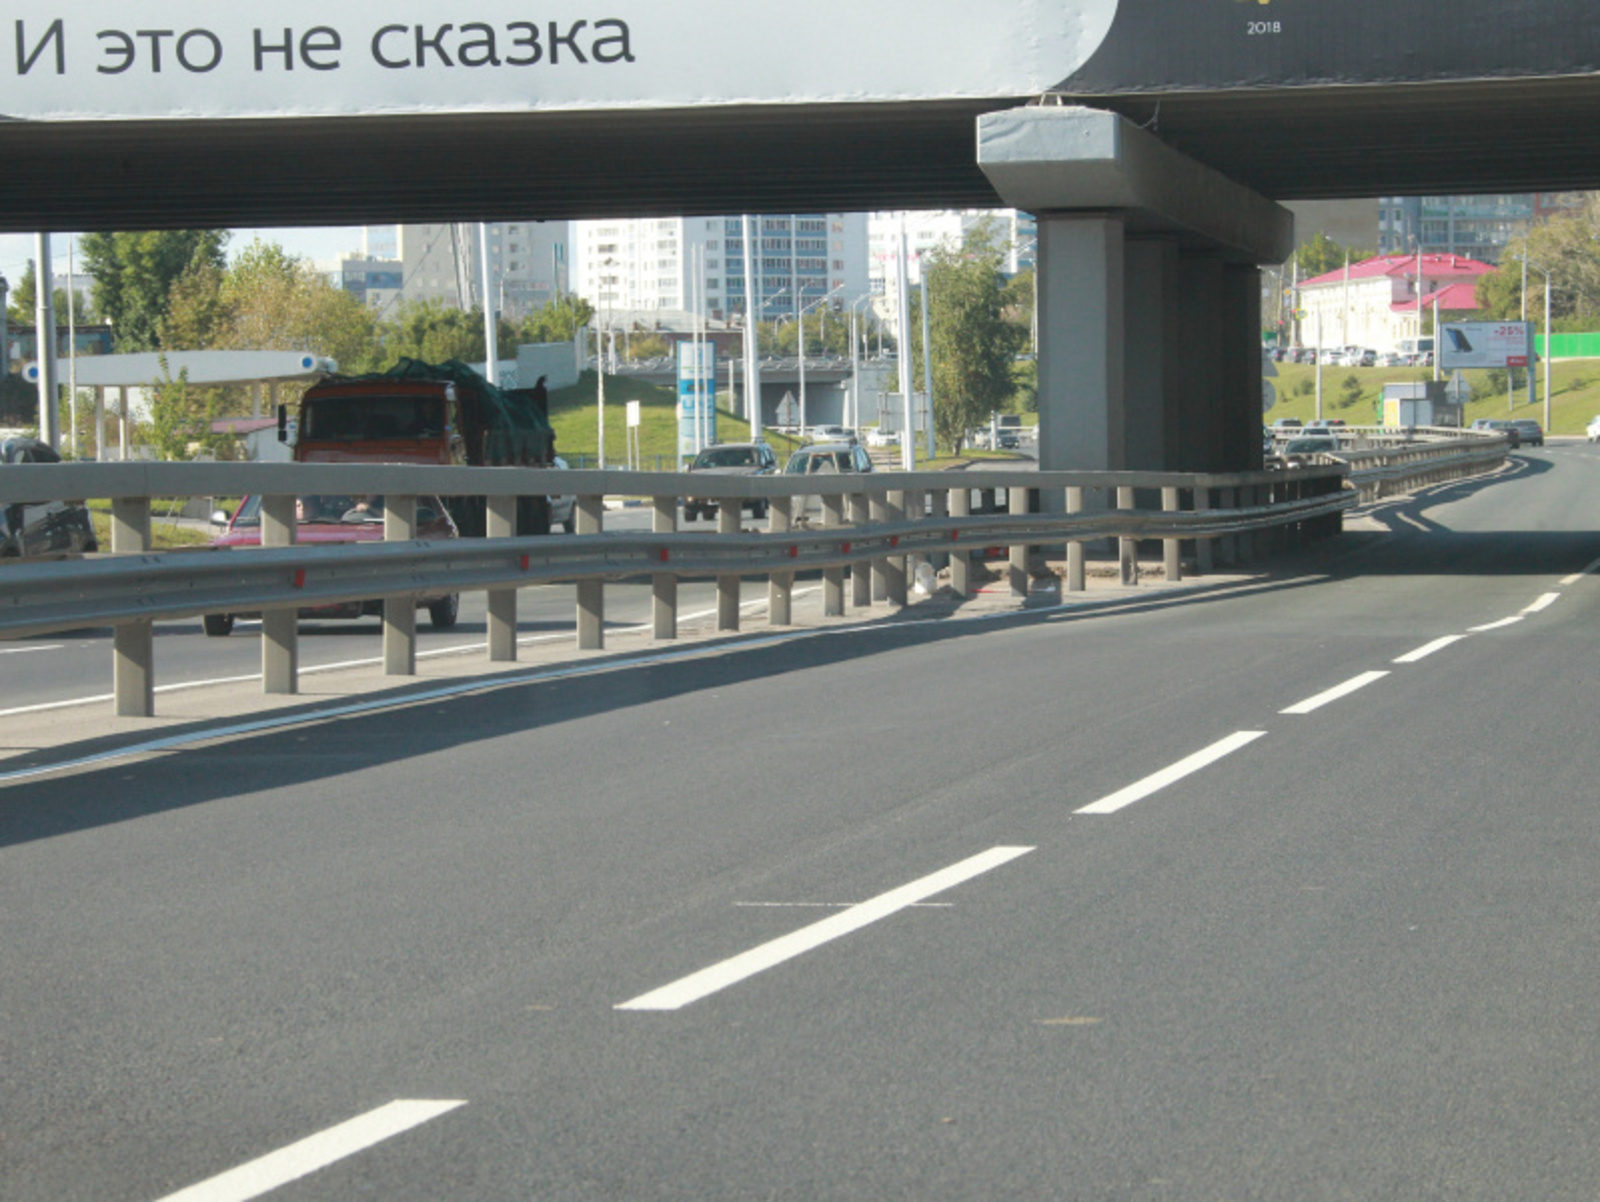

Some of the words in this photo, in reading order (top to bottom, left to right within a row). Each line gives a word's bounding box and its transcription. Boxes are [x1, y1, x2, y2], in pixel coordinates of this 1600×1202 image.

[1247, 21, 1281, 35] 2018
[15, 19, 65, 75] И
[96, 28, 223, 75] это
[253, 25, 342, 71] не
[371, 18, 636, 69] сказка
